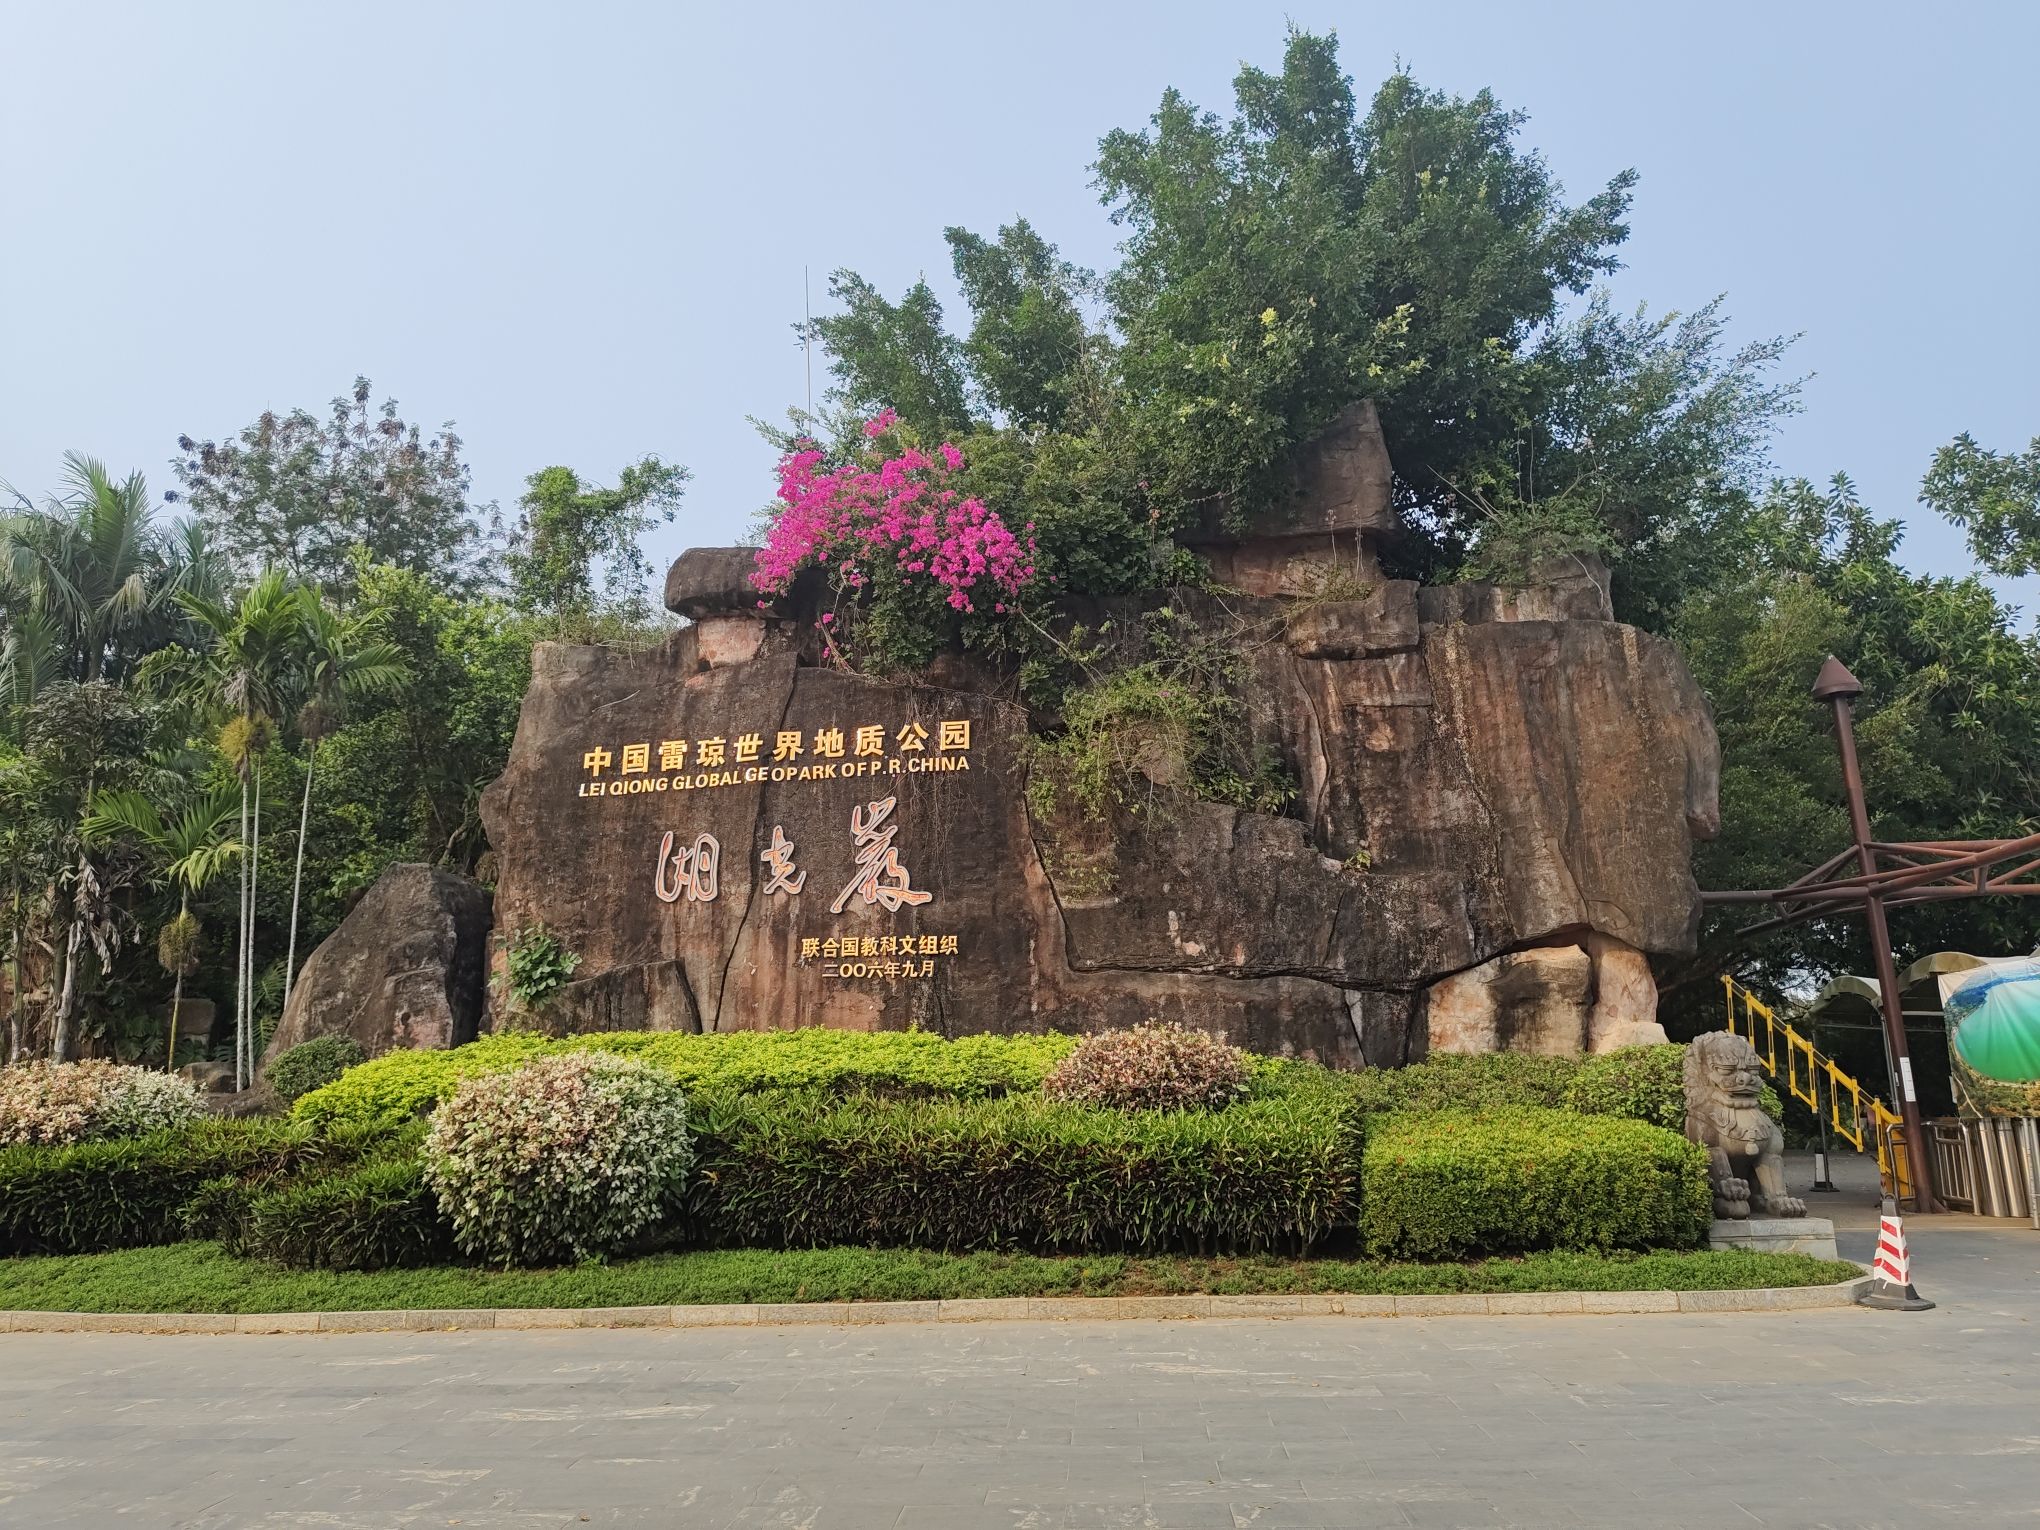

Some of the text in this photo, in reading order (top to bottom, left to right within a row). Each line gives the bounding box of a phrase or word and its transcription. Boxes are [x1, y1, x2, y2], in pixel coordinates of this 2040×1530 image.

[583, 720, 970, 777] 中国雷琼世界地质公园
[579, 783, 606, 797] LEI
[609, 778, 668, 796] QIONG
[672, 771, 742, 791] GLOBAL
[841, 762, 867, 777] OF
[802, 935, 959, 958] 联合国教科文组织
